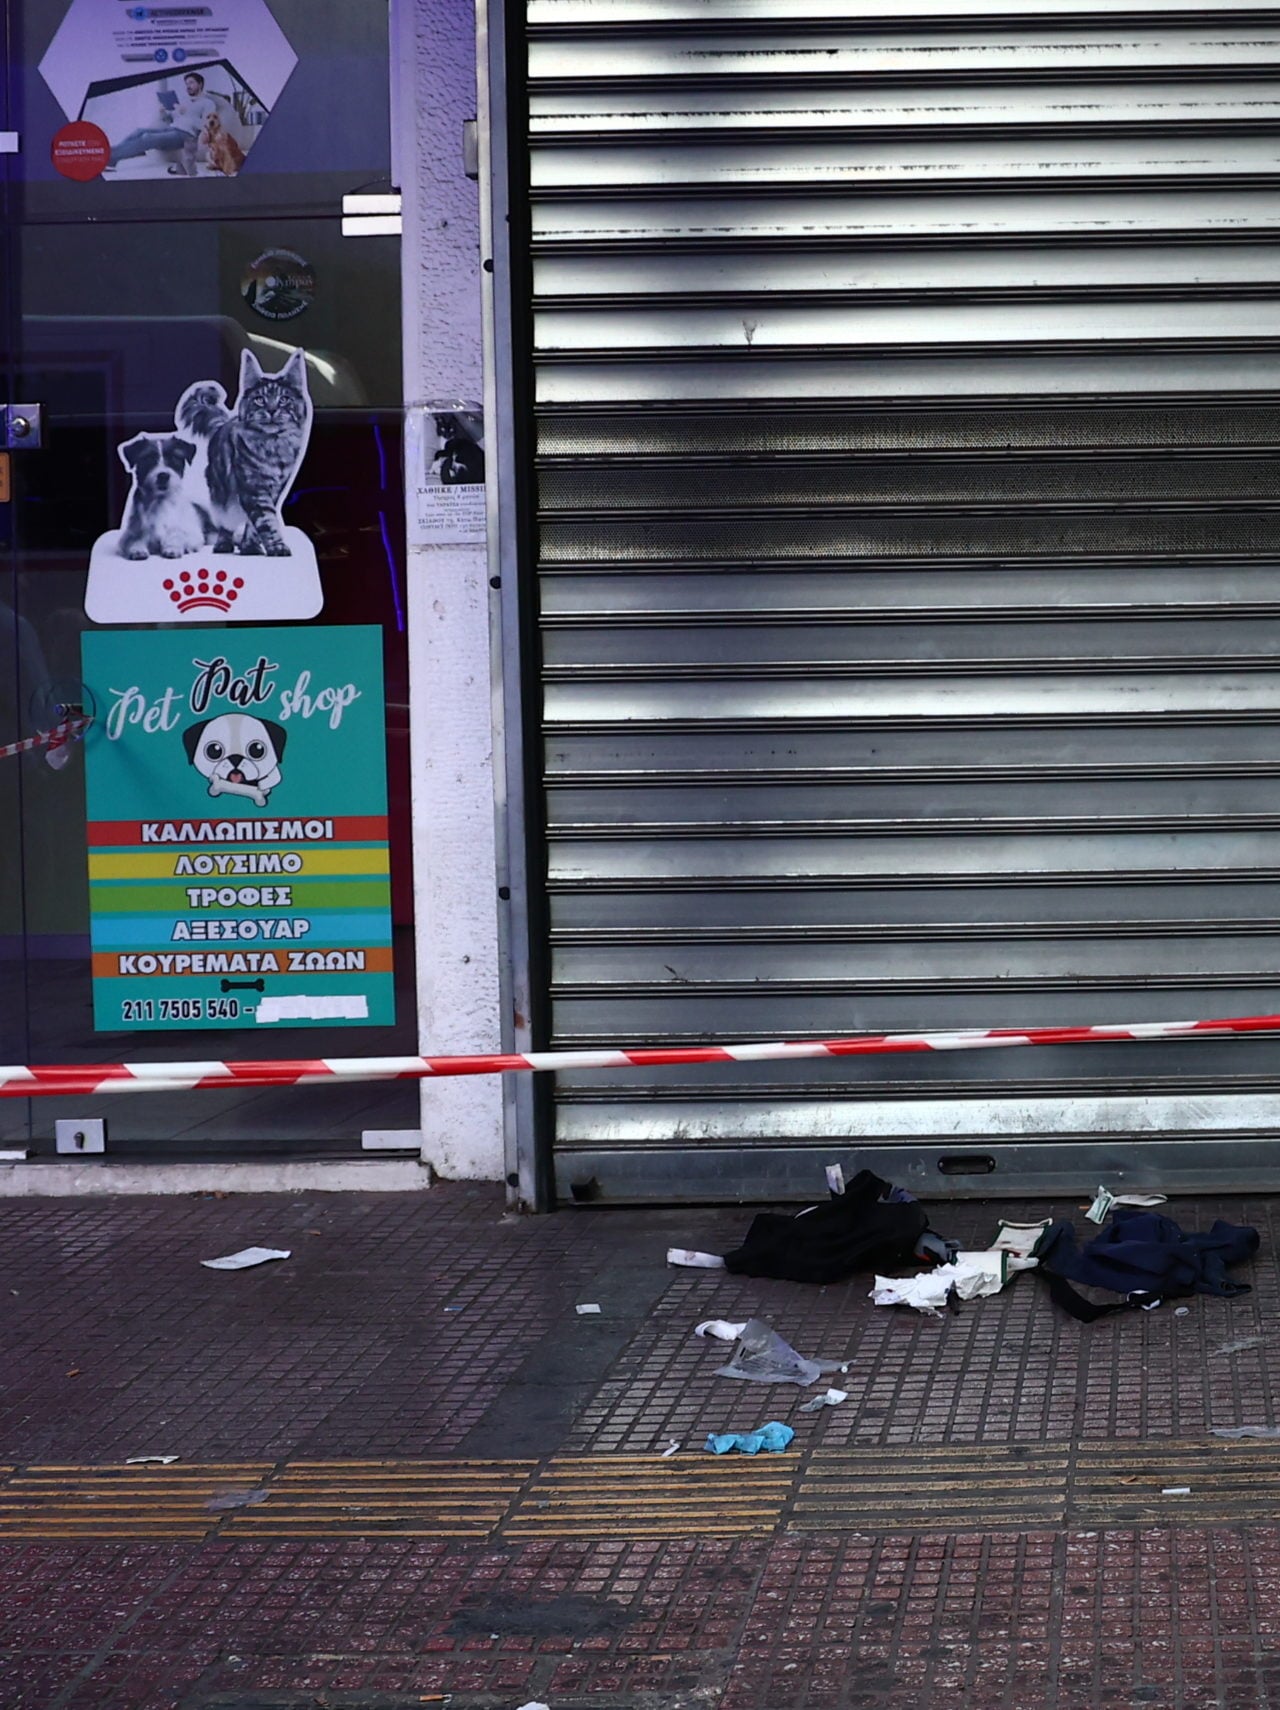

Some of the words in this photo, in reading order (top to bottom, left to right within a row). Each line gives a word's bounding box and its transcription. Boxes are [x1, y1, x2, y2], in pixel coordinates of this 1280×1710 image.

[106, 686, 184, 741] Pet
[189, 656, 279, 715] Pat
[279, 670, 362, 729] shop
[141, 818, 334, 843] ΚΑΛΛΩΠΙΣΜΟΙ
[173, 853, 303, 876] ΛΟΥΣΙΜΟ
[186, 886, 292, 908] ΤΡΟΦΕΣ
[170, 918, 310, 942] ΑΞΕΣΟΥΑΡ
[118, 952, 279, 975] ΚΟΥΡΕΜΑΤΑ
[286, 950, 366, 972] ΖΩΩΝ
[122, 1000, 153, 1021] 211
[160, 999, 201, 1020] 7505
[207, 998, 239, 1019] 540
